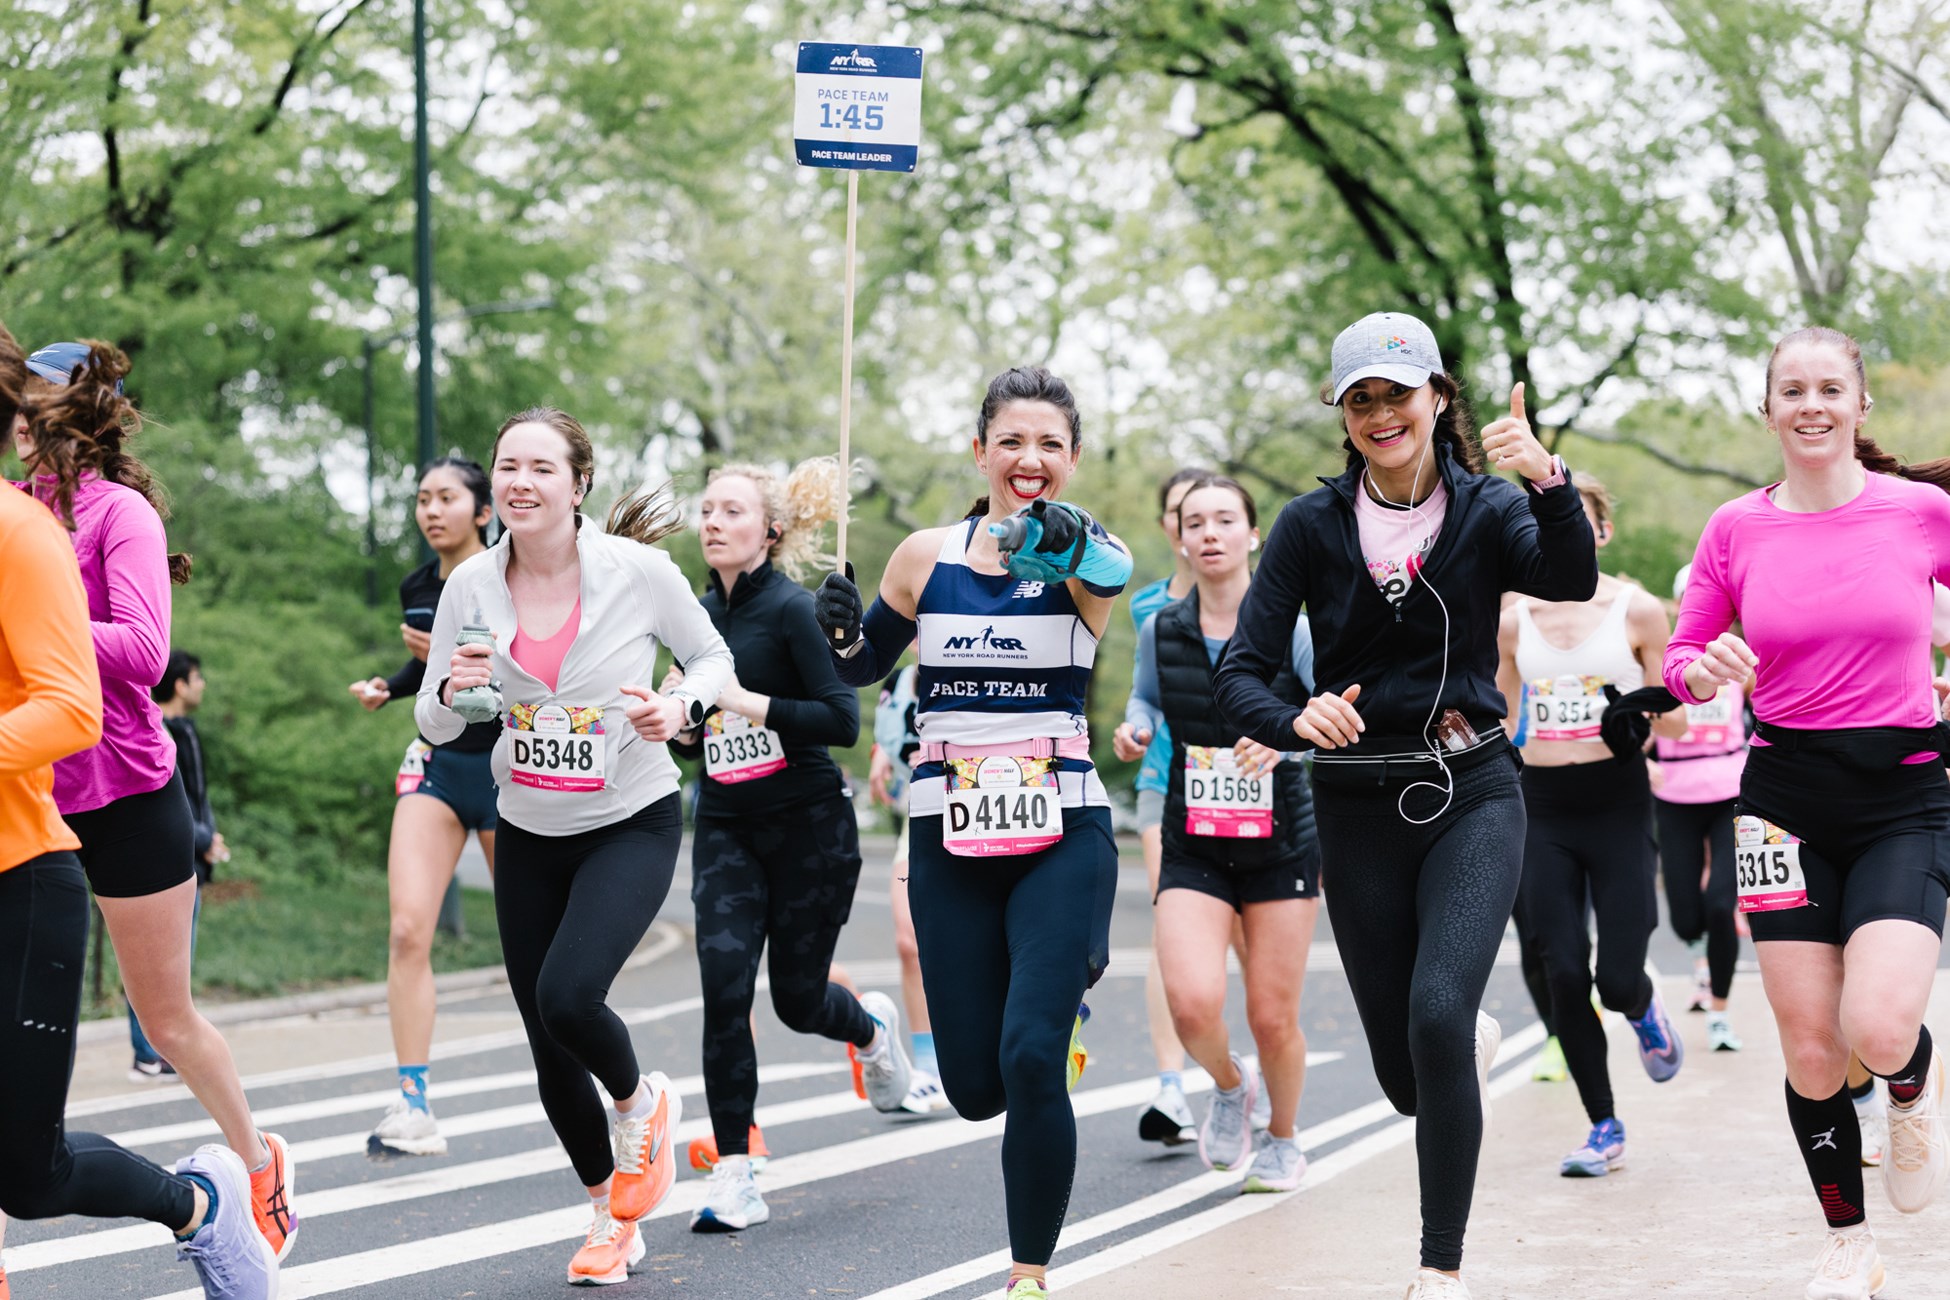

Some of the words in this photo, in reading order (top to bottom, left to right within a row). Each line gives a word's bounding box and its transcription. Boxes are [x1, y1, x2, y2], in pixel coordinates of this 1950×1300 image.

[818, 89, 848, 100] PACE
[852, 90, 889, 102] TEAM
[820, 102, 884, 131] 1:45
[811, 150, 832, 160] PACE
[833, 151, 856, 161] TEAM
[856, 152, 892, 163] LEADER
[943, 636, 1028, 651] NYRR
[930, 681, 979, 697] PACE
[984, 681, 1048, 697] TEAM
[514, 738, 594, 771] D5348
